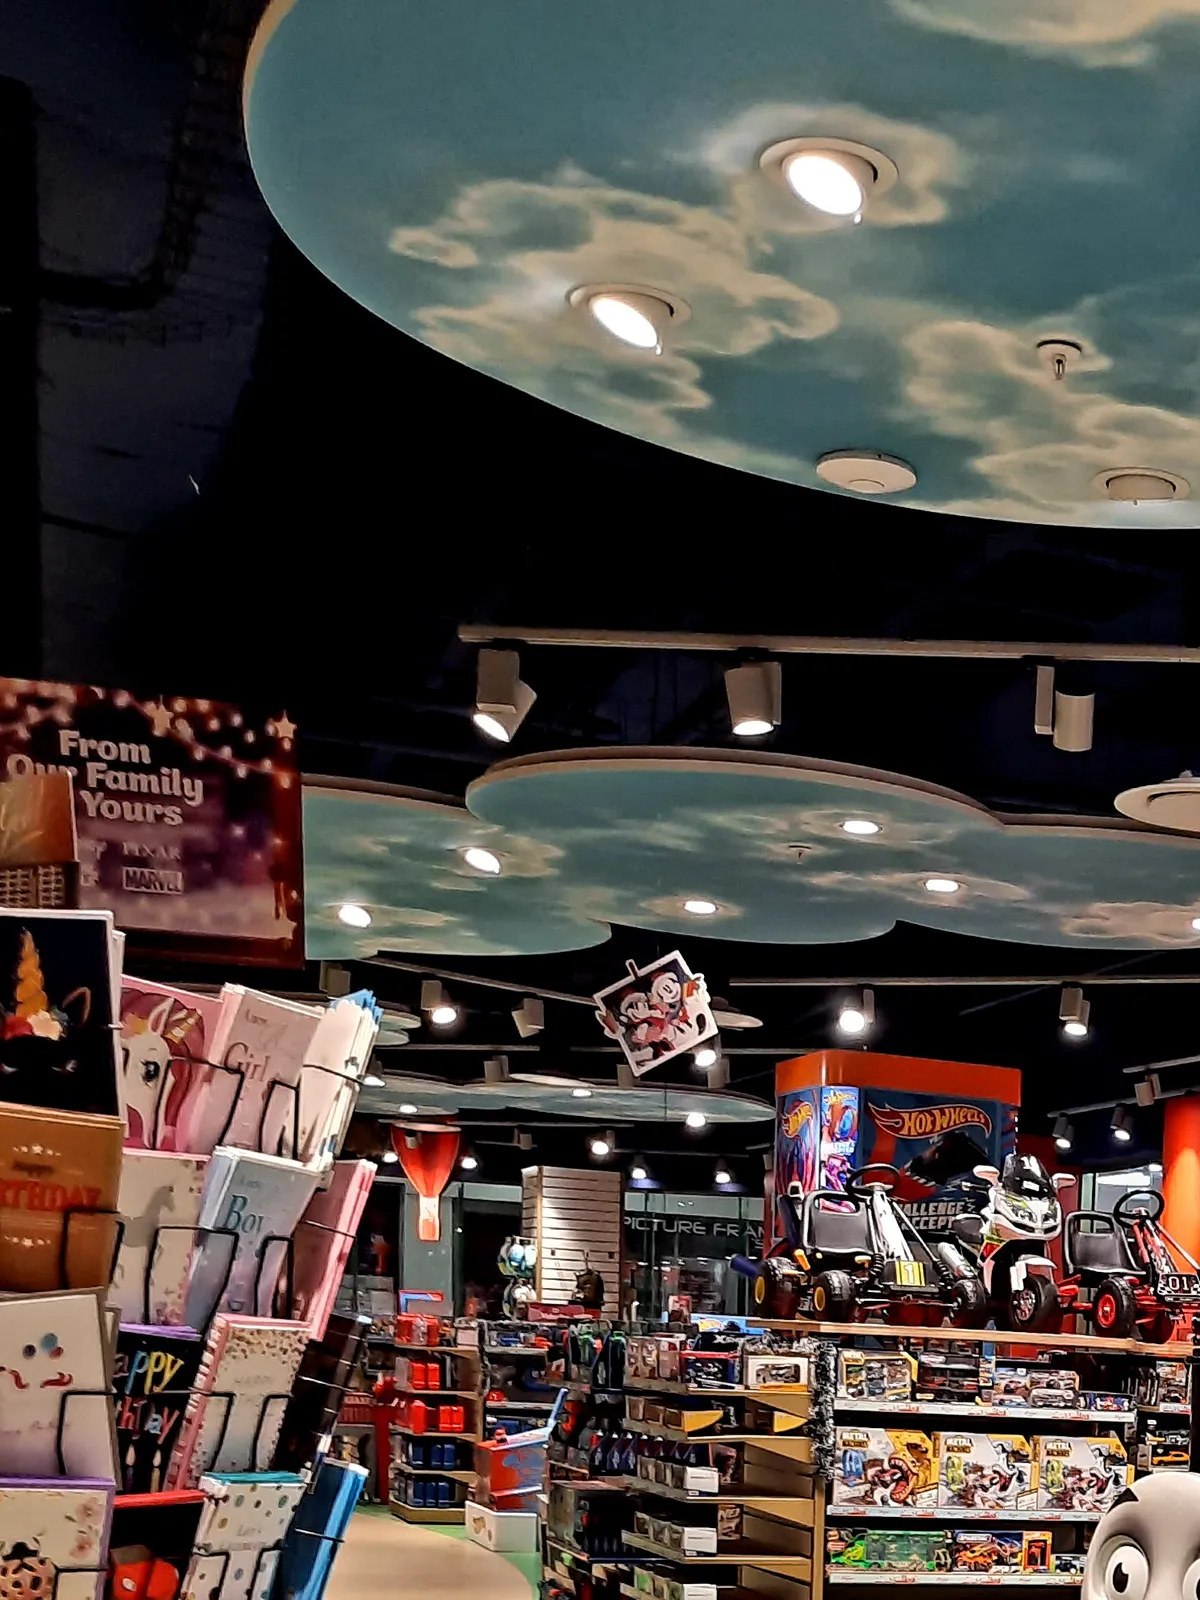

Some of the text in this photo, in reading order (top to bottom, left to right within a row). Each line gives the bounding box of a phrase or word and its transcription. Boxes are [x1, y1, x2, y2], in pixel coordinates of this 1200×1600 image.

[59, 729, 151, 764] From
[86, 762, 204, 806] Family
[79, 790, 183, 826] Yours
[224, 1042, 270, 1082] Girl
[900, 1201, 965, 1216] ALLENGE
[903, 1264, 914, 1284] 1
[1168, 1276, 1190, 1291] 01
[113, 1350, 184, 1395] appy
